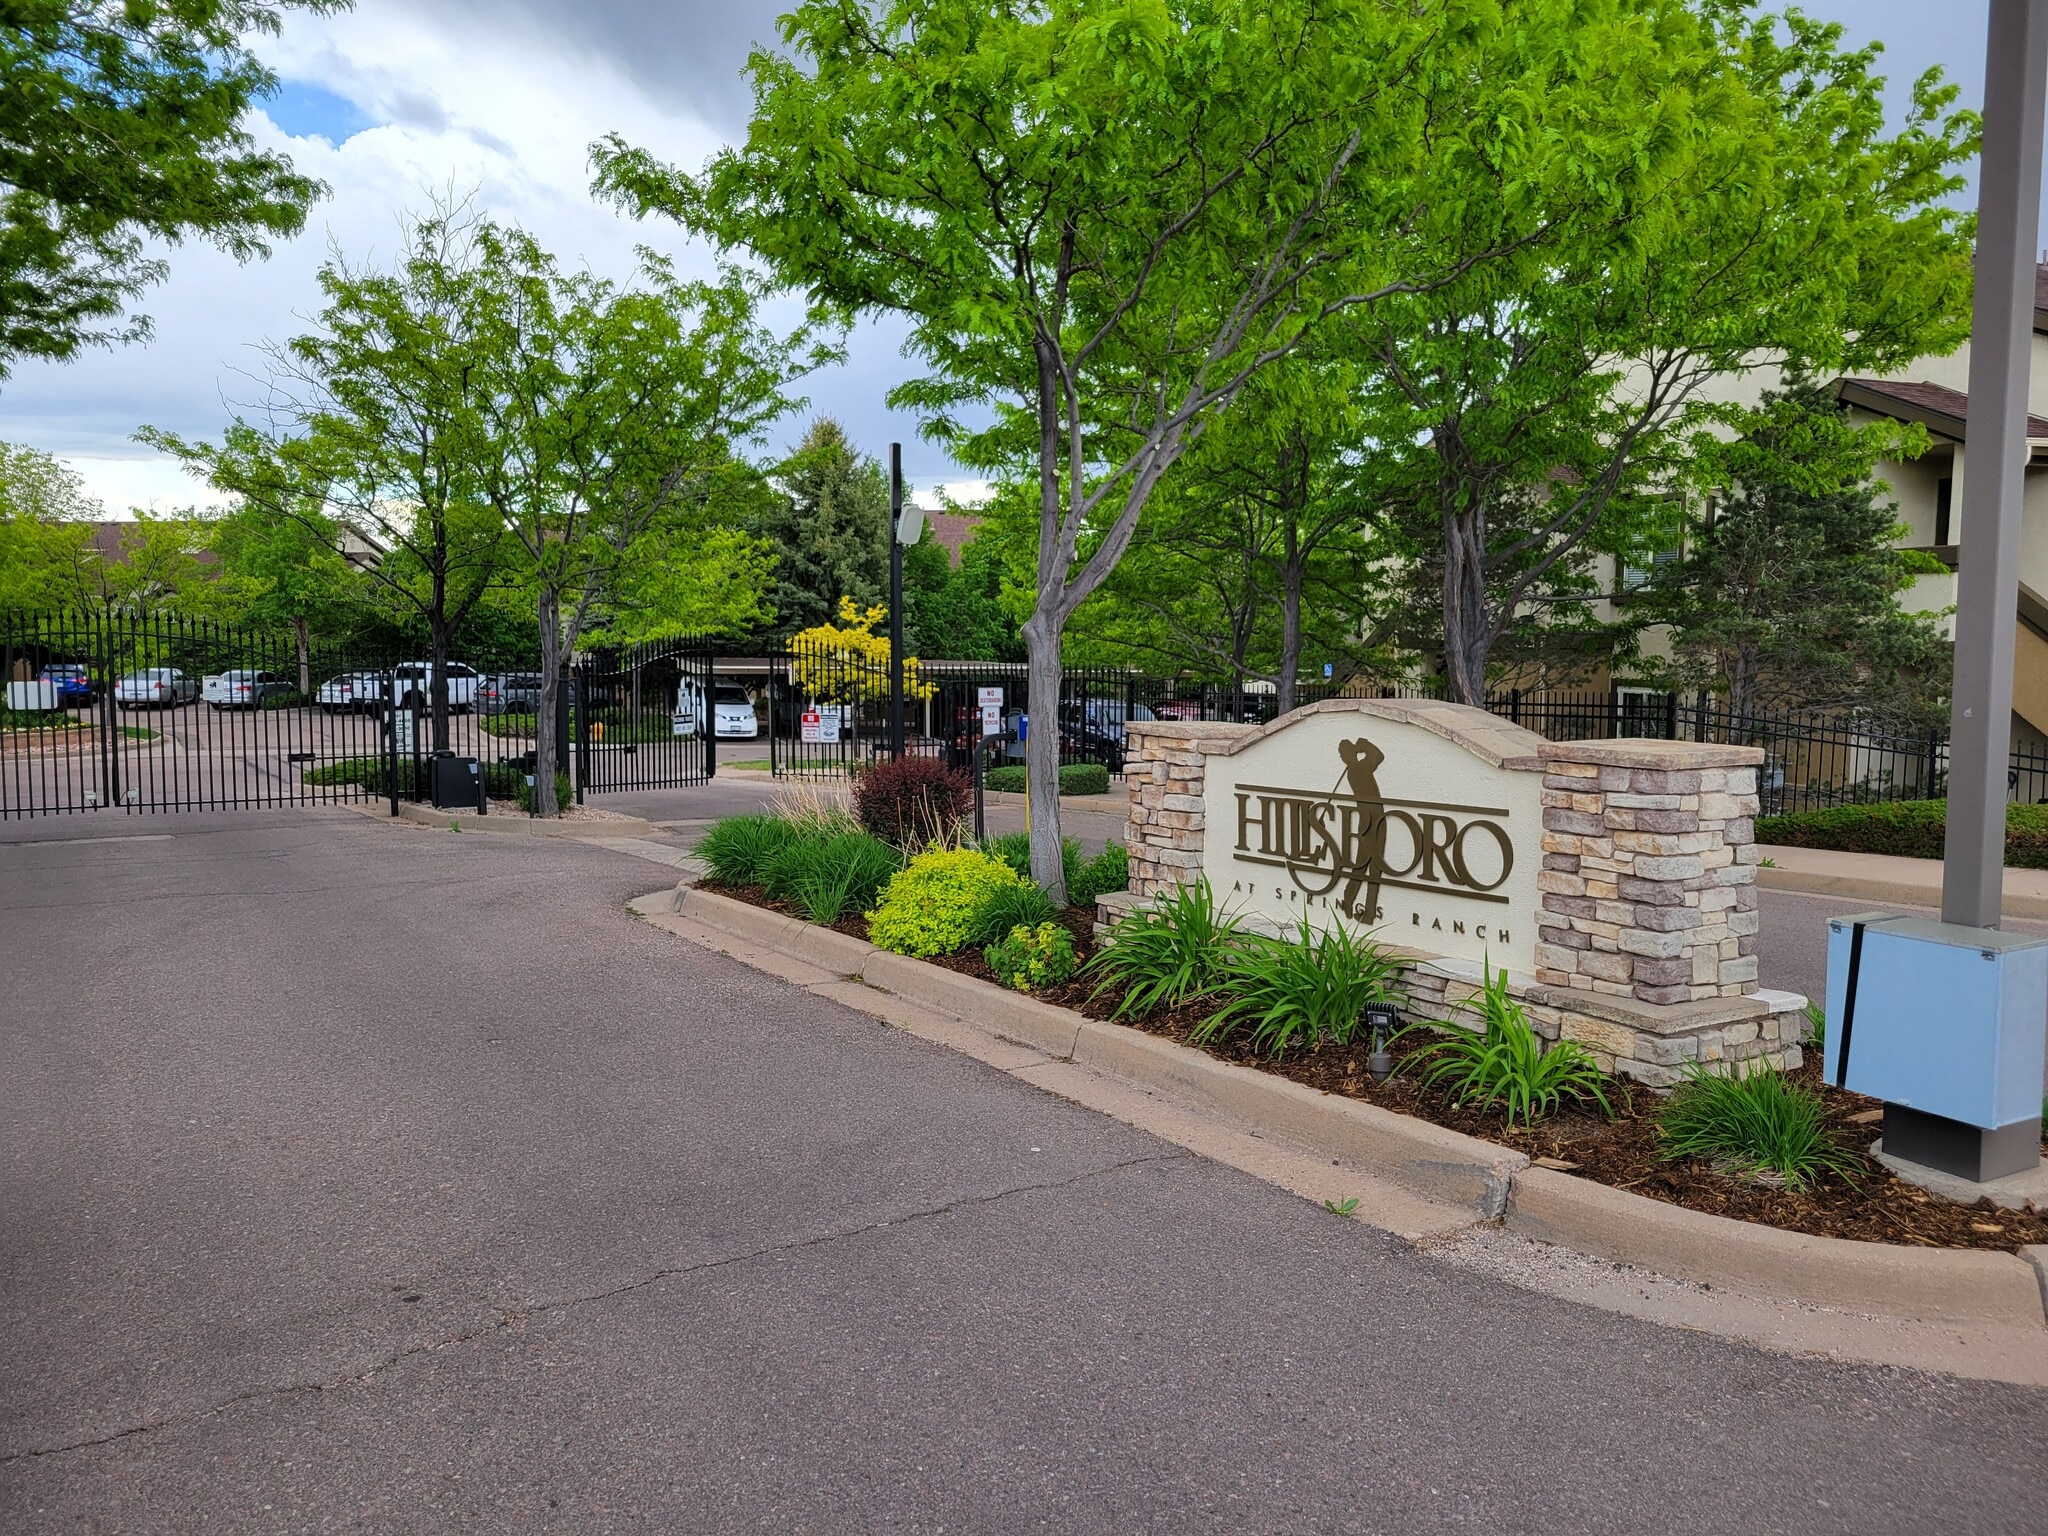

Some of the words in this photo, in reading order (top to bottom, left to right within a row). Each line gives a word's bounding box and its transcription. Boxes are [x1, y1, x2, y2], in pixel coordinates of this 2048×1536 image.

[1233, 793, 1514, 896] HILLSBORO
[1233, 880, 1255, 894] AT
[1275, 887, 1383, 919] SPRINGS
[1412, 912, 1510, 943] RANCH
